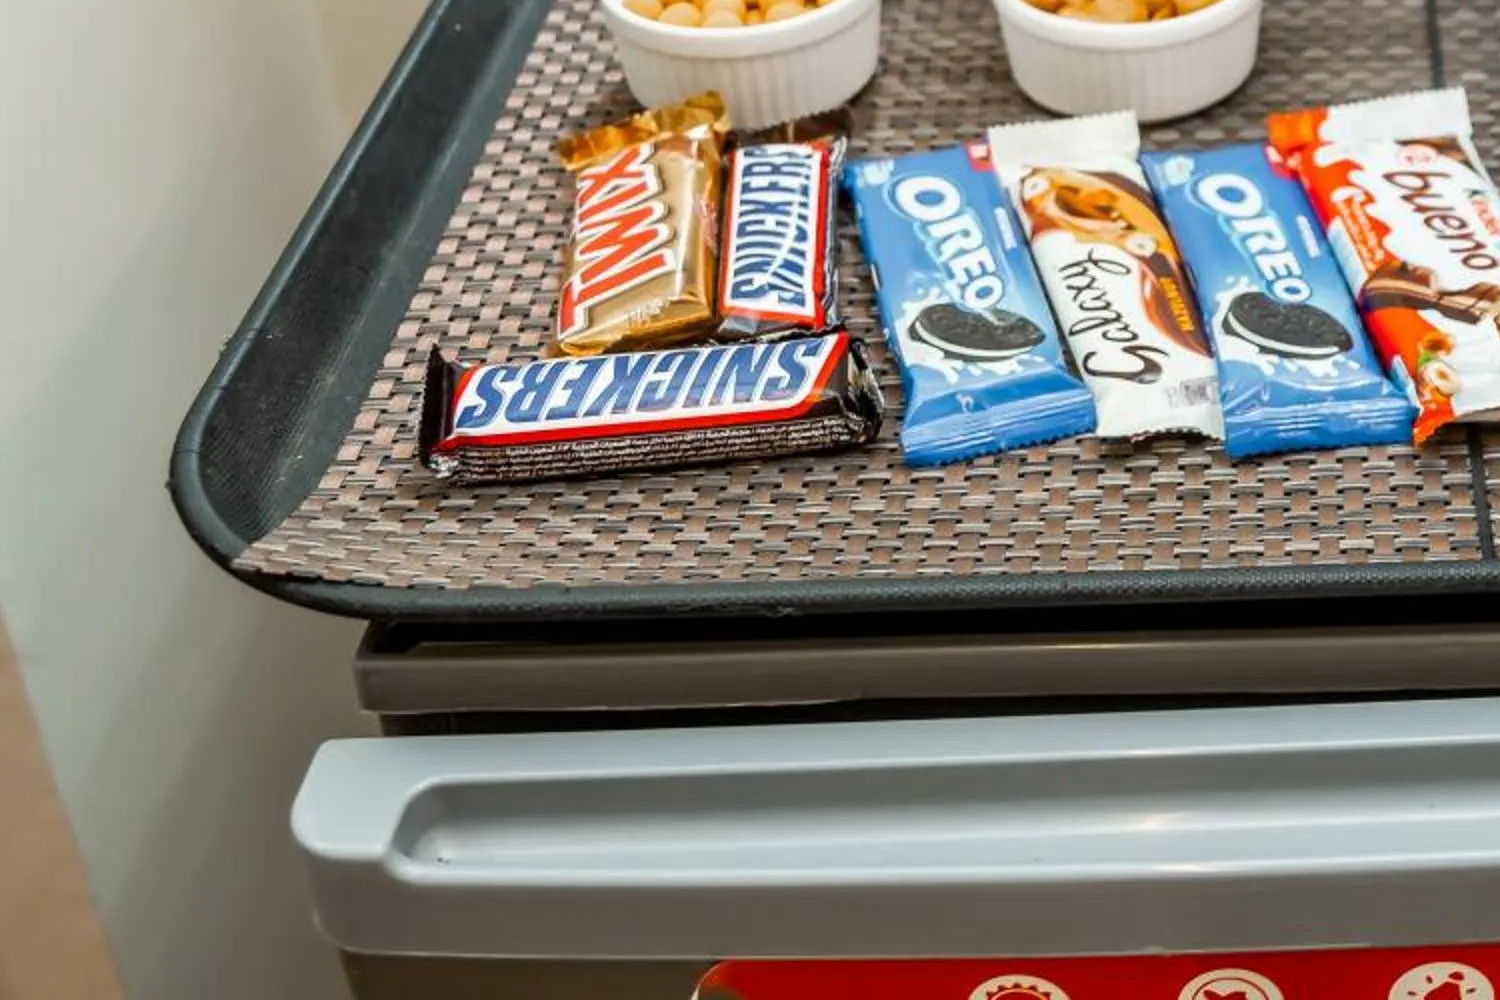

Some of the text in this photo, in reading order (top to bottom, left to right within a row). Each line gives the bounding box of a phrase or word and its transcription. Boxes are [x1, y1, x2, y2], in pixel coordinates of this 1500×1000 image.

[558, 144, 675, 336] TWIX
[895, 174, 1004, 309] OREO
[1197, 173, 1312, 304] OREO
[1380, 170, 1500, 272] bueno
[456, 337, 829, 429] SNICKERS
[1058, 248, 1171, 385] Galaxy
